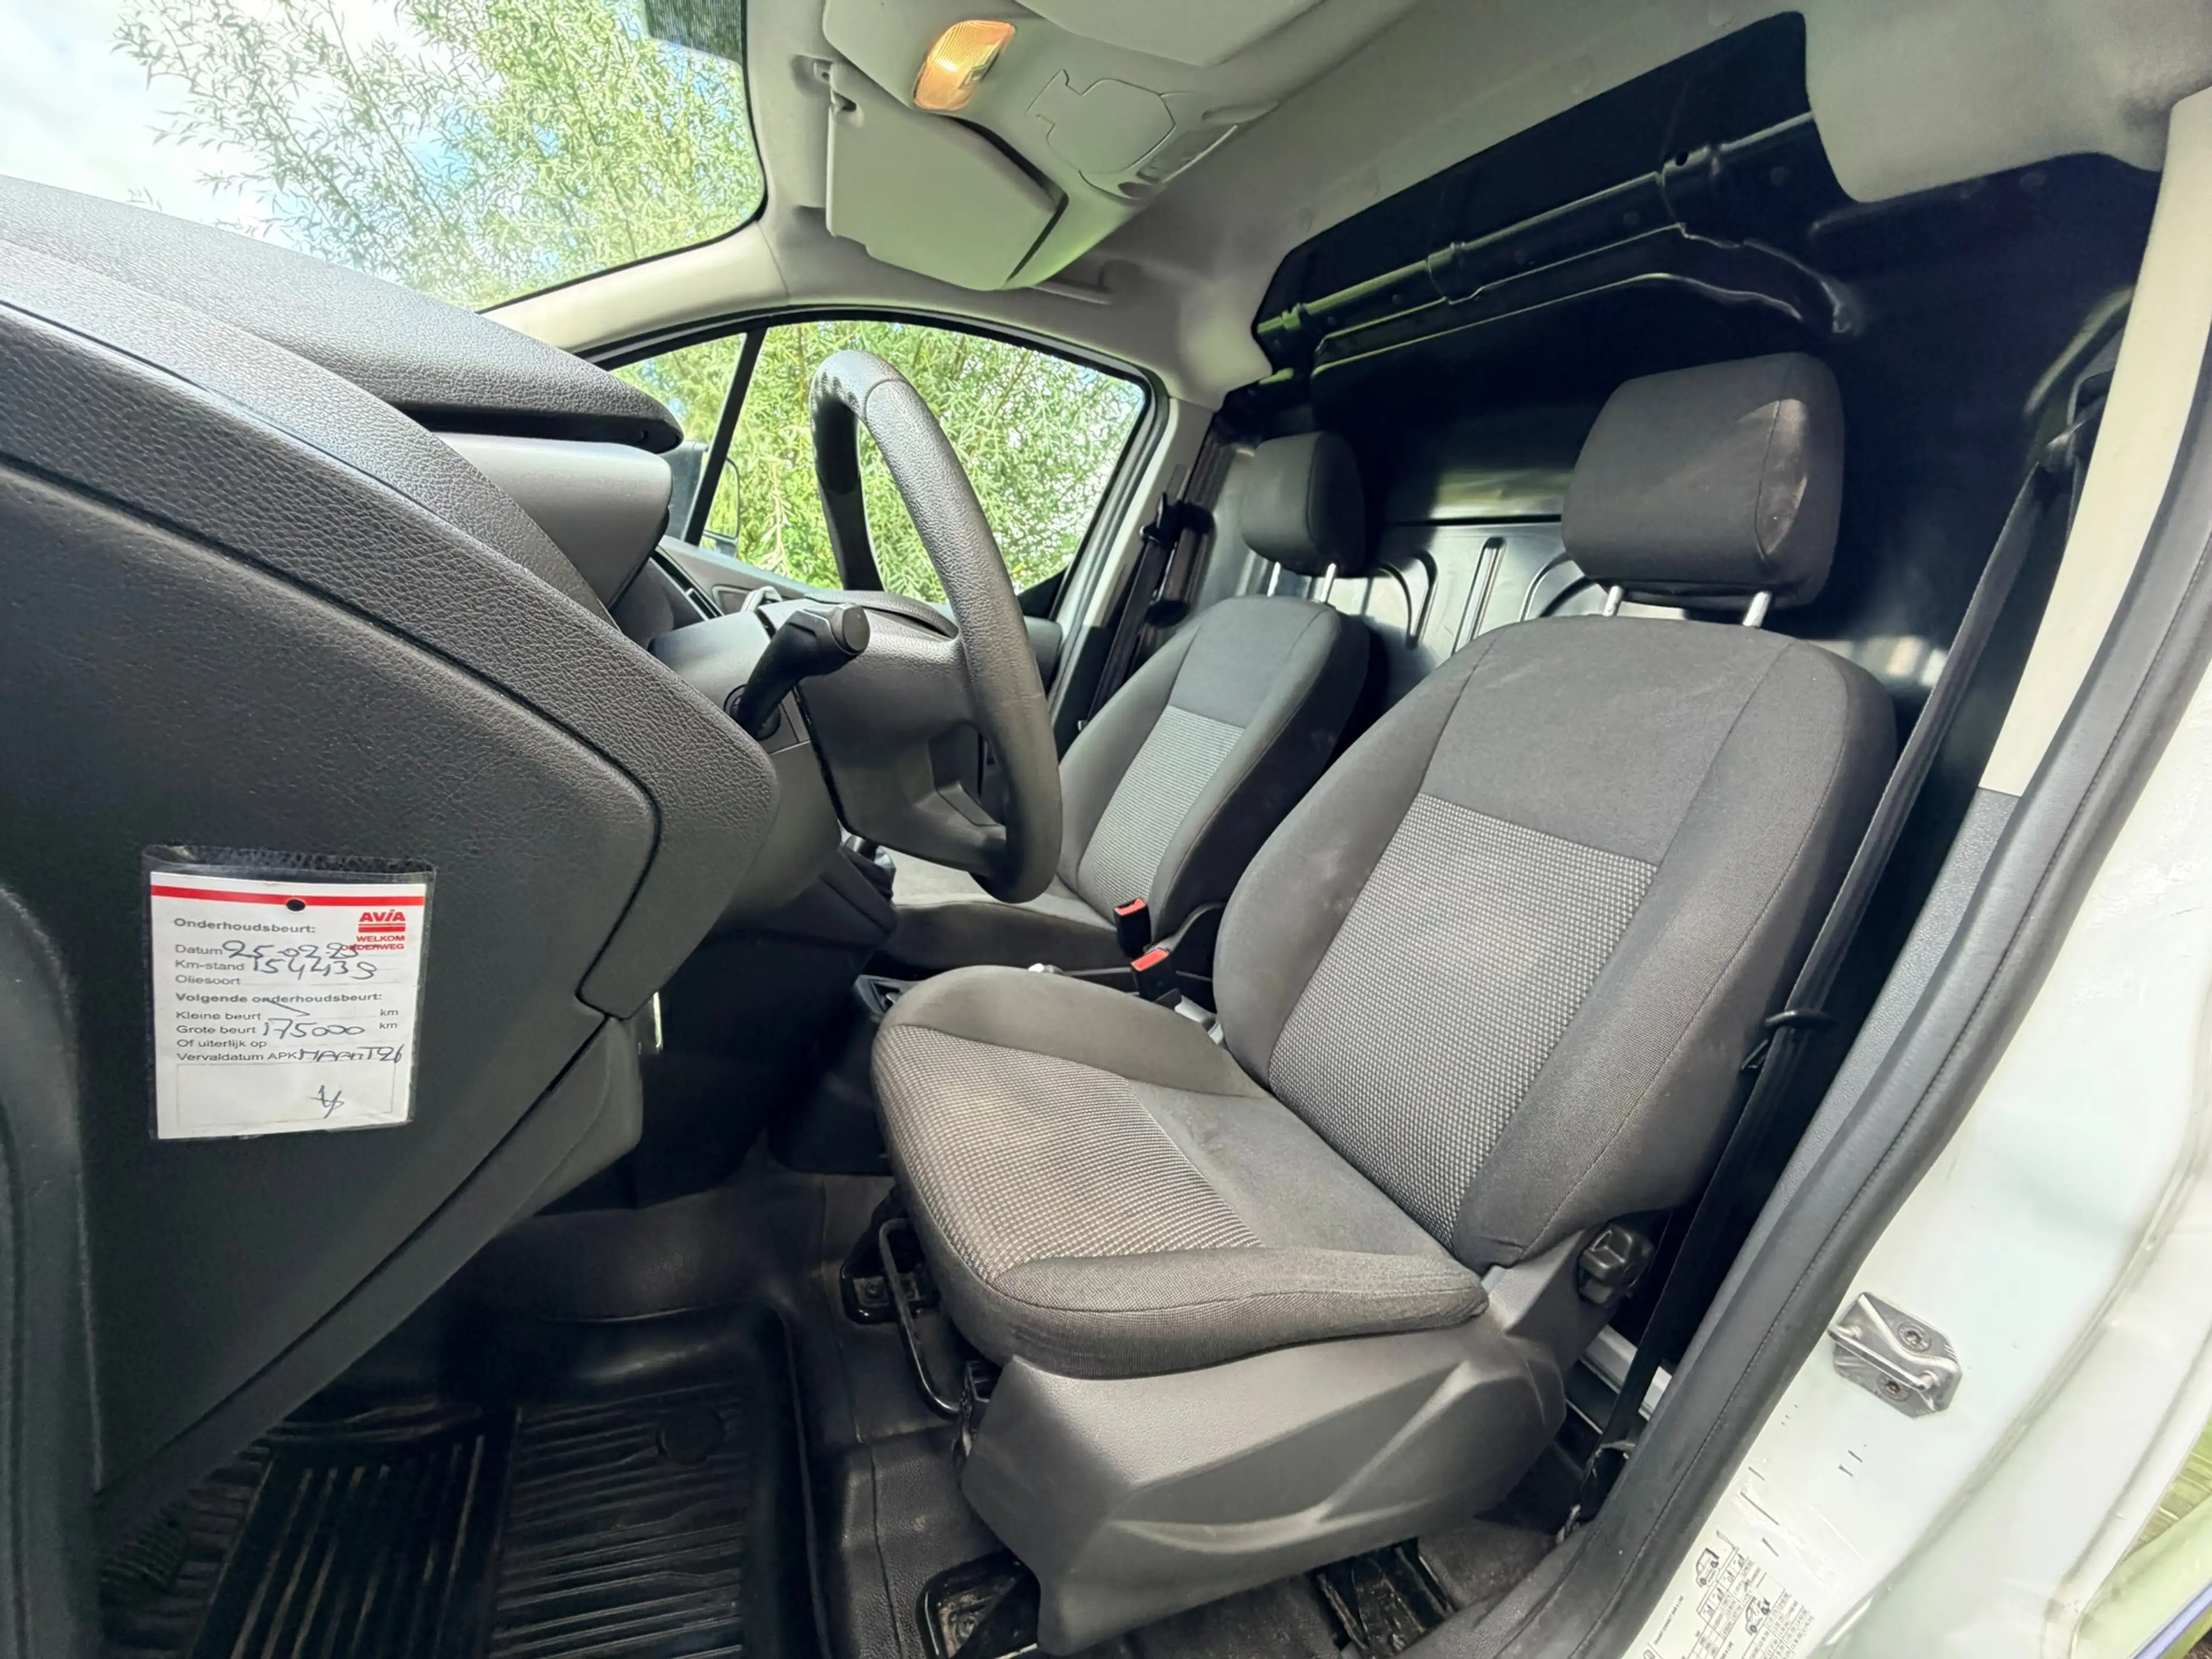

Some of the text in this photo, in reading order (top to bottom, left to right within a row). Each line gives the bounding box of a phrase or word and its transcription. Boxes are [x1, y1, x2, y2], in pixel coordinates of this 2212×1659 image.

[173, 918, 315, 933] Onderhoudsbeurt:
[175, 944, 222, 956] Datum
[175, 959, 244, 971] Km-stand
[175, 974, 240, 985] Oliesoort
[176, 992, 382, 1004] Volgende onderhoudsbeurt:
[176, 1011, 221, 1020] Kleine
[225, 1012, 261, 1020] beurt
[176, 1025, 216, 1034] Grote
[220, 1026, 256, 1034] beurt
[262, 1017, 365, 1040] 175000
[177, 1039, 267, 1049] Of uiterlijk op
[177, 1051, 298, 1061] Vervaldatum APK
